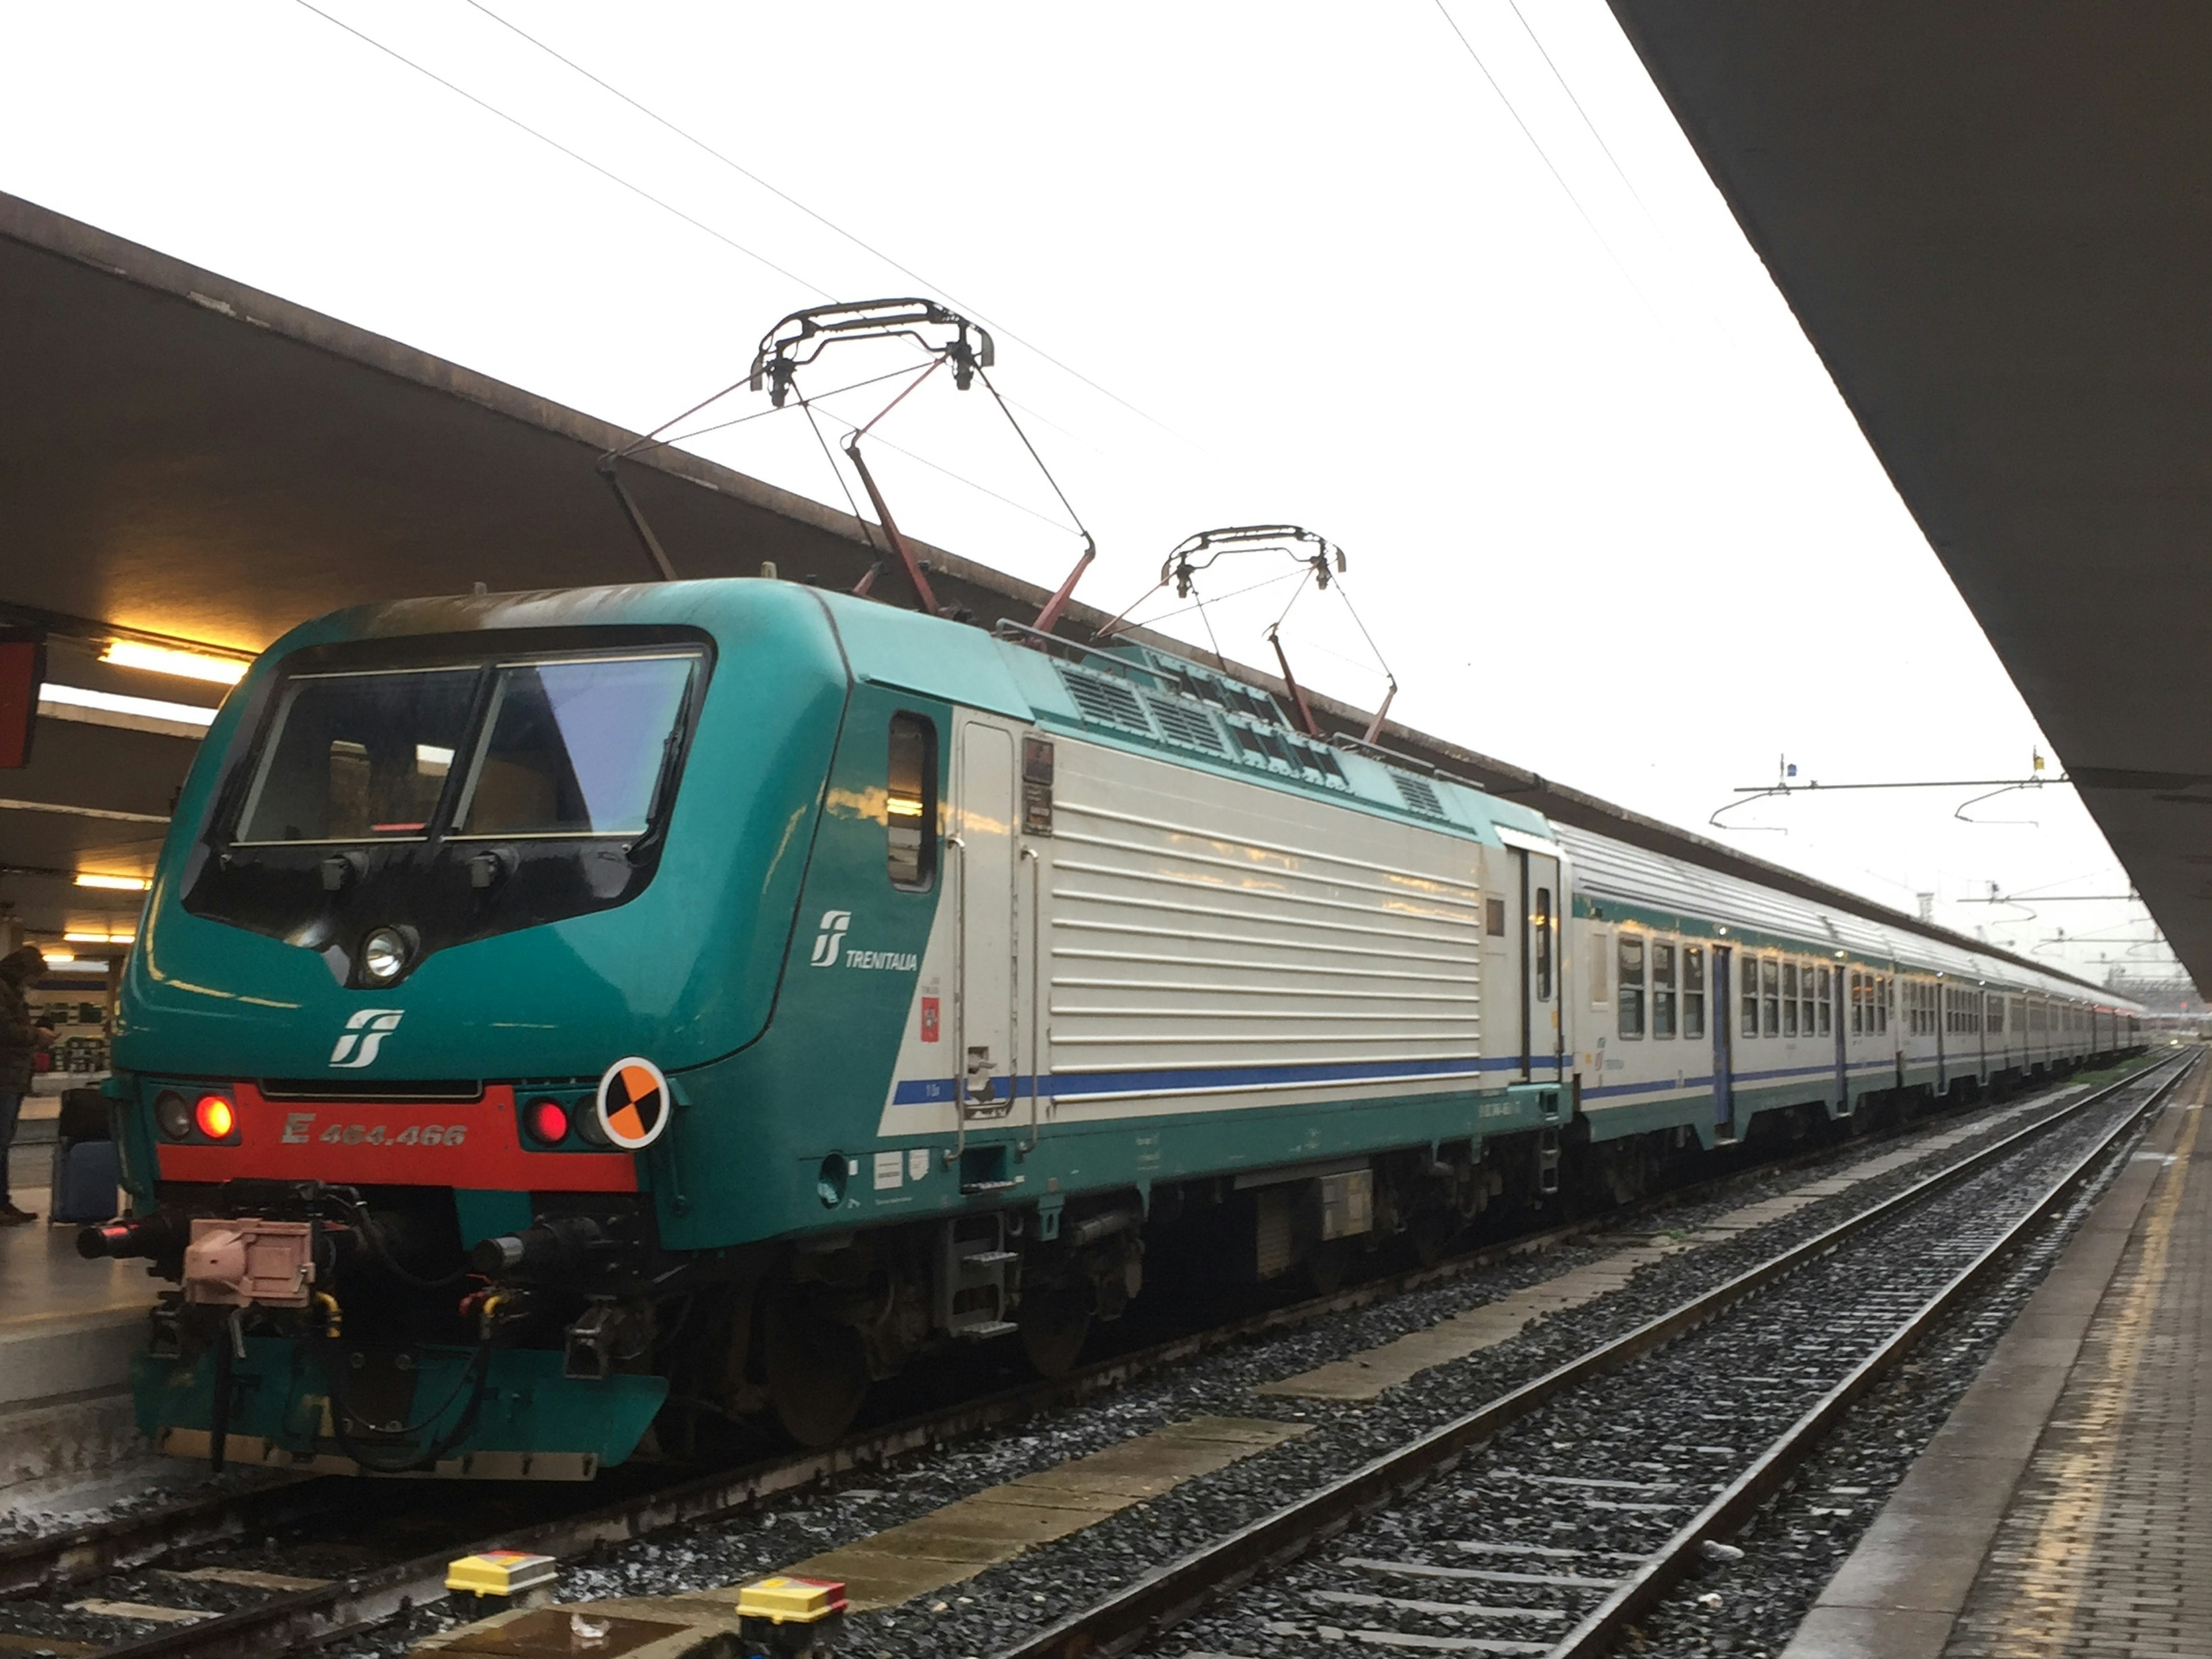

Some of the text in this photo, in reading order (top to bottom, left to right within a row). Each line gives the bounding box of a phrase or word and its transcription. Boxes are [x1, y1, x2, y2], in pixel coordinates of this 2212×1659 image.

[846, 950, 918, 971] TRENITALIA
[281, 1112, 468, 1146] E 464.466
